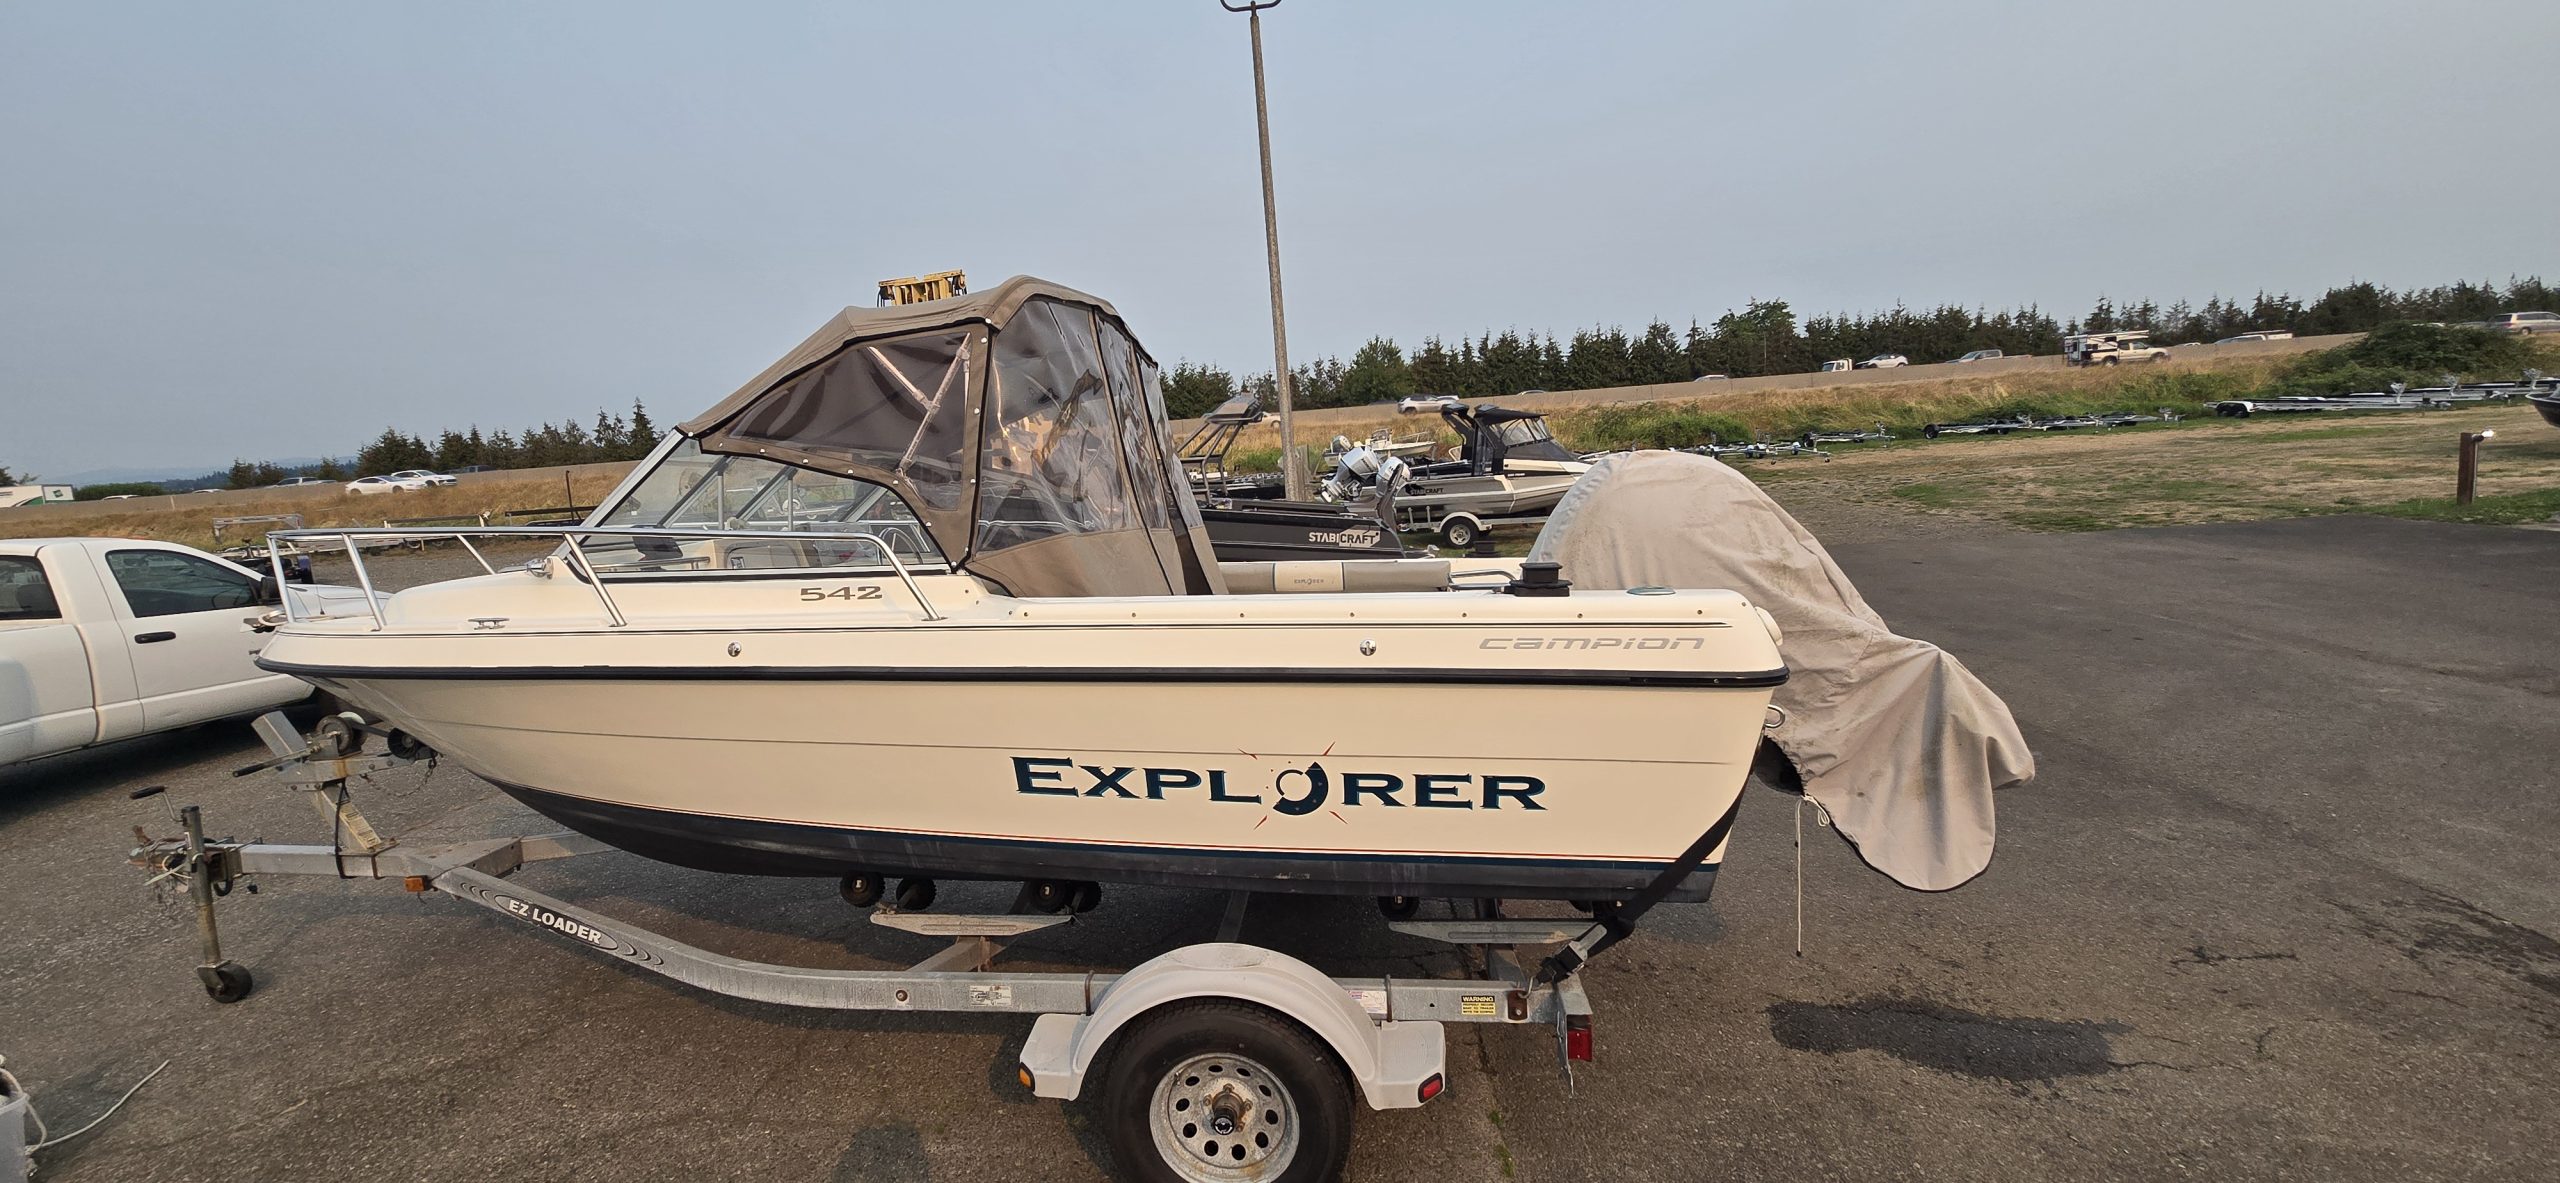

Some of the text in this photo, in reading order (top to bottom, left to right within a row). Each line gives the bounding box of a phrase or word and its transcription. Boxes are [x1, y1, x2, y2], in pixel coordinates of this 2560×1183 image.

[1308, 532, 1376, 545] STABICRAFT
[800, 586, 883, 601] 542
[1010, 755, 1548, 816] EXPLORER
[508, 899, 602, 945] EZ LOADER
